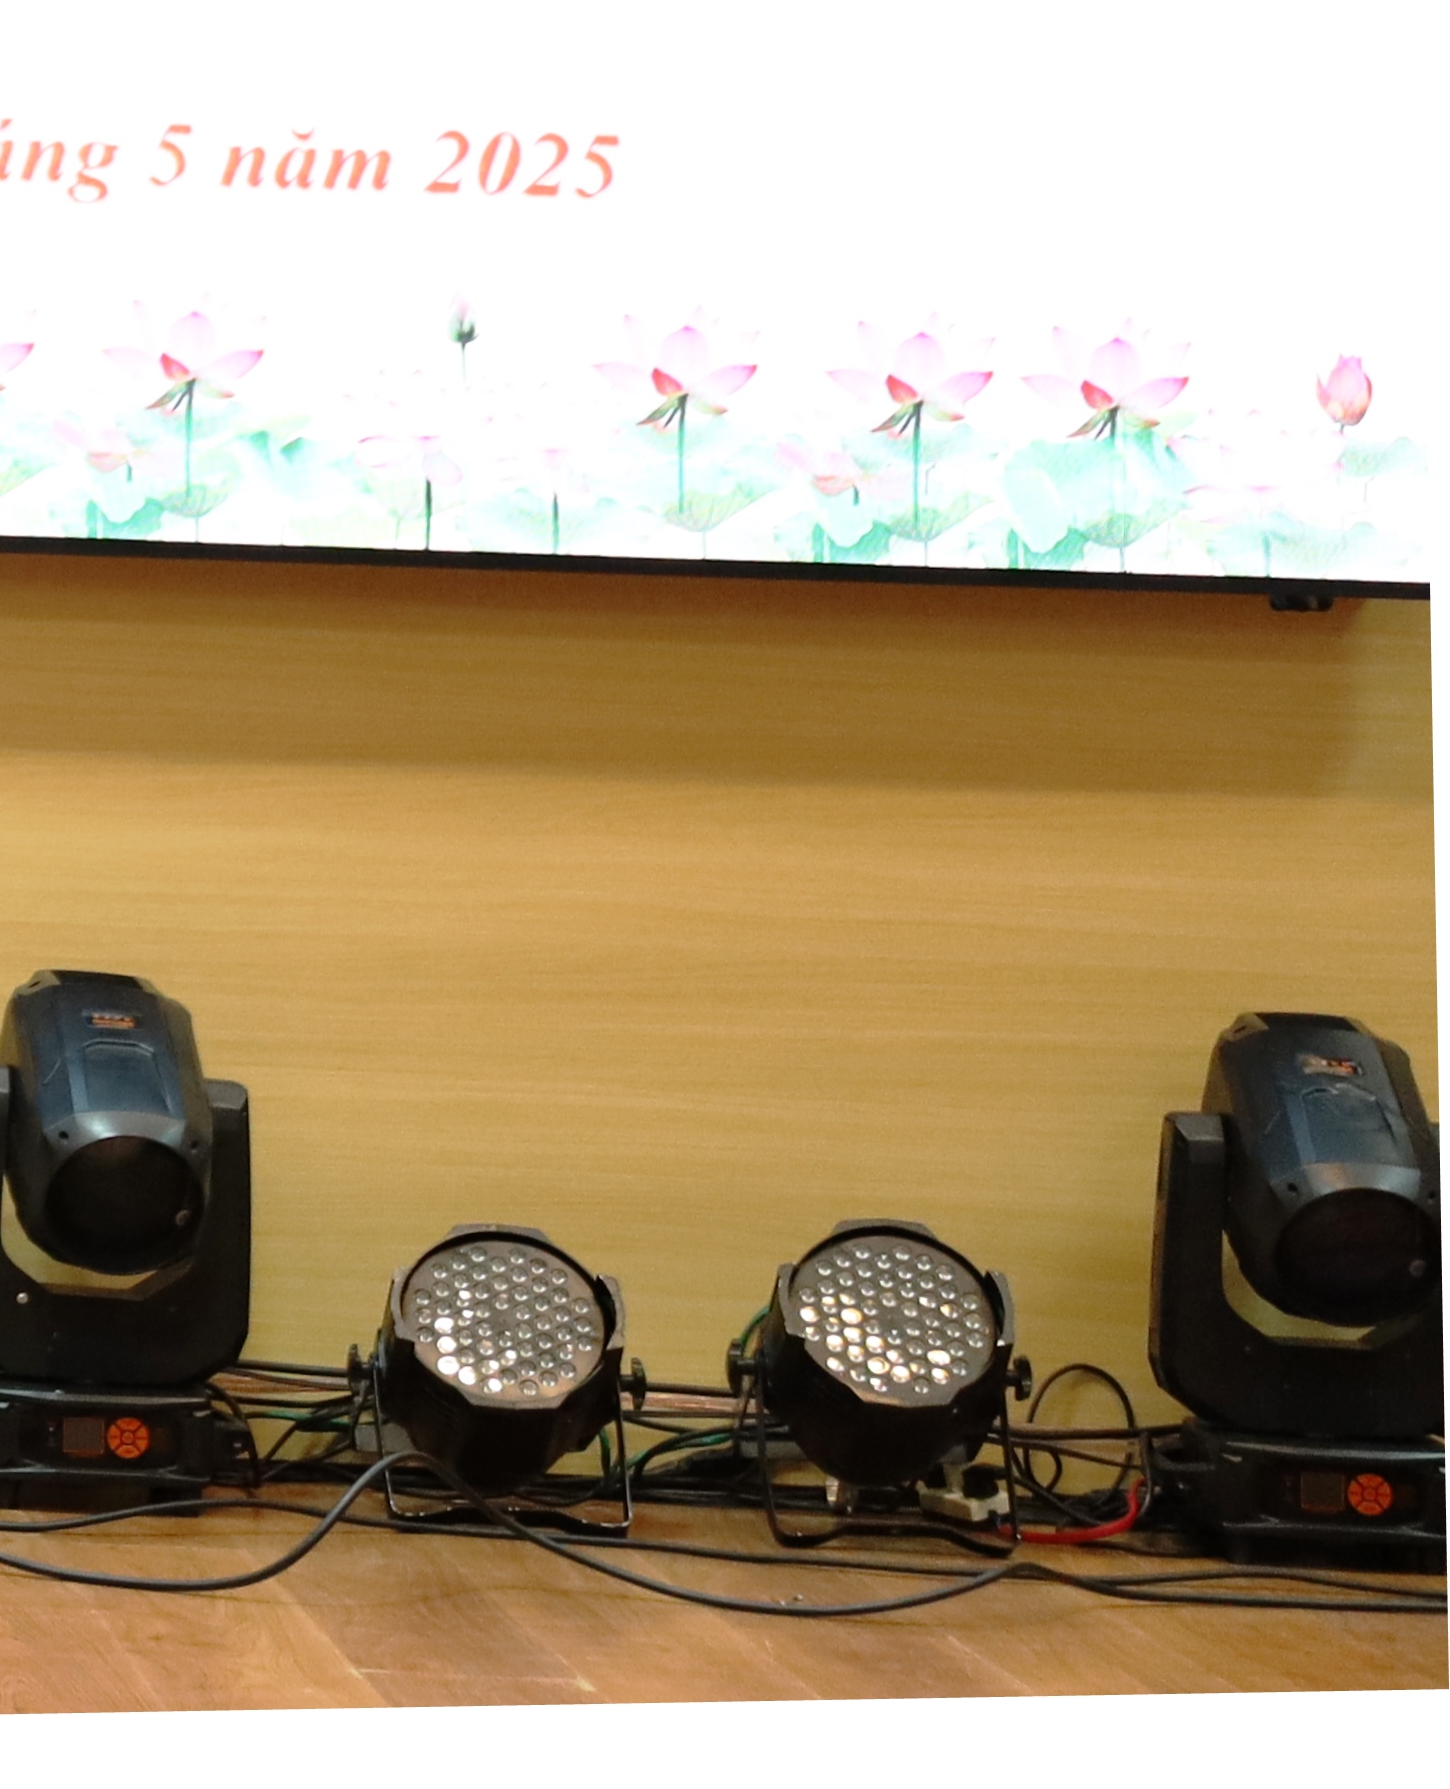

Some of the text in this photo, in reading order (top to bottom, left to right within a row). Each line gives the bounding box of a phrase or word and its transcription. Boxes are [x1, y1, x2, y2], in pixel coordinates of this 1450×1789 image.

[150, 124, 192, 186] 5
[221, 132, 391, 191] năm
[425, 130, 619, 199] 2025
